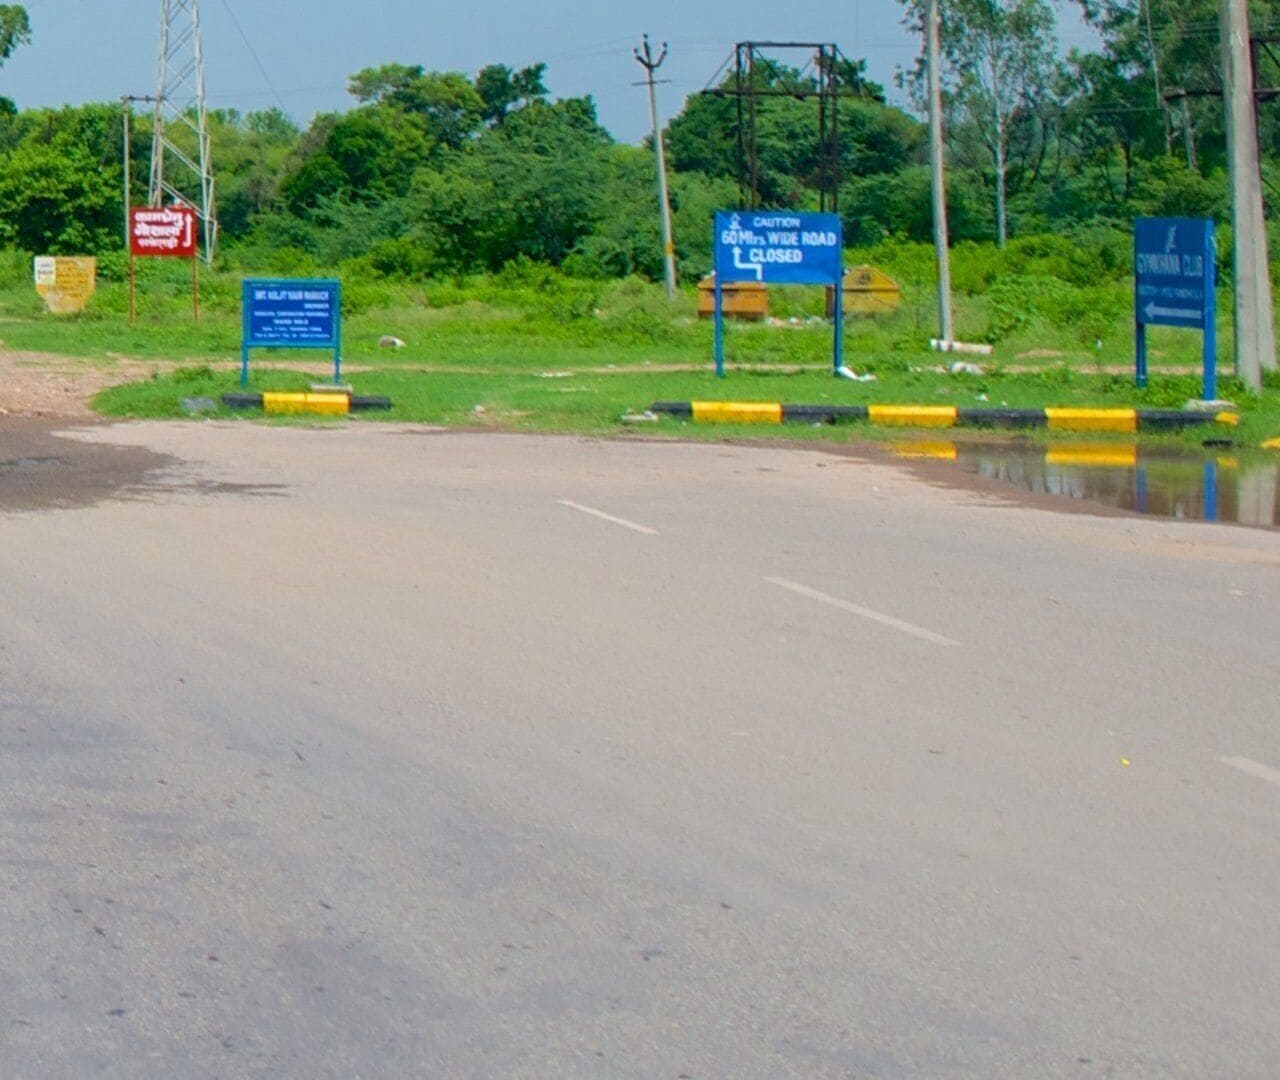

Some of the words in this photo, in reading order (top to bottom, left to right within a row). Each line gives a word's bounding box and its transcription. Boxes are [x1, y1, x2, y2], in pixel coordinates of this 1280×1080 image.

[753, 216, 800, 228] CAUTION
[722, 230, 738, 245] 60
[768, 231, 799, 246] WIDE
[802, 232, 837, 247] ROAD
[749, 248, 803, 264] CLOSED
